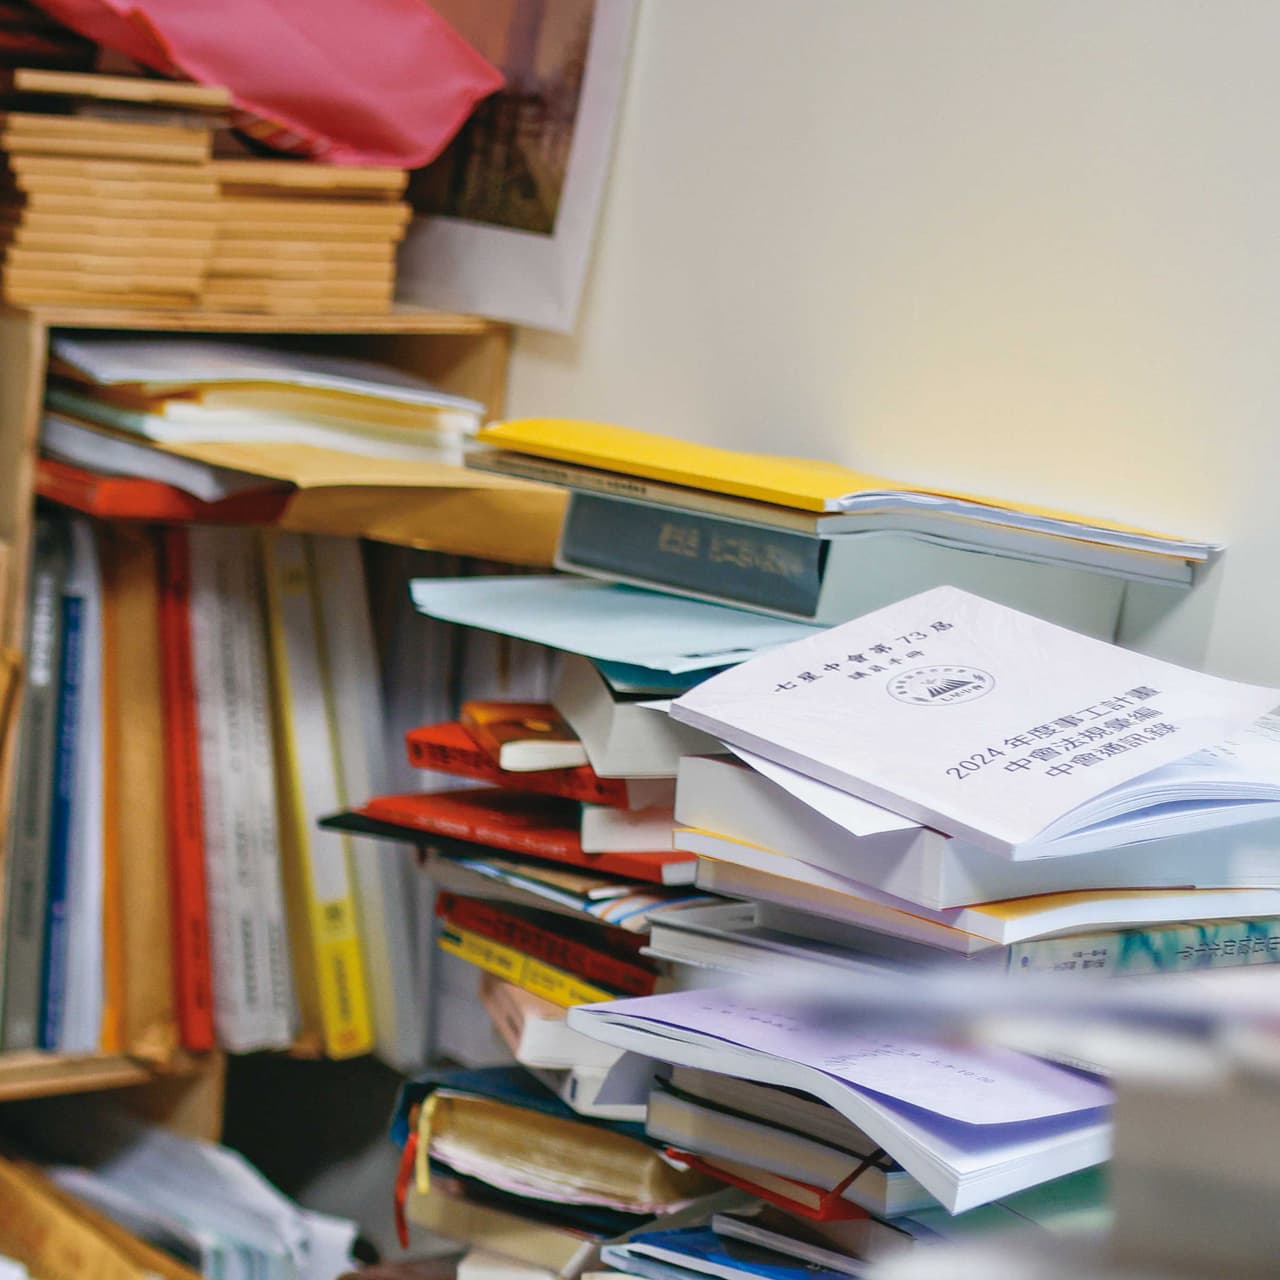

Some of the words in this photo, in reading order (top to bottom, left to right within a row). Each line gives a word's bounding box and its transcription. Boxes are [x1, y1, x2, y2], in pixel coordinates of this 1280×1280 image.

[1003, 706, 1163, 773] 中會法規彙編
[1045, 722, 1180, 777] 中會通訊錄
